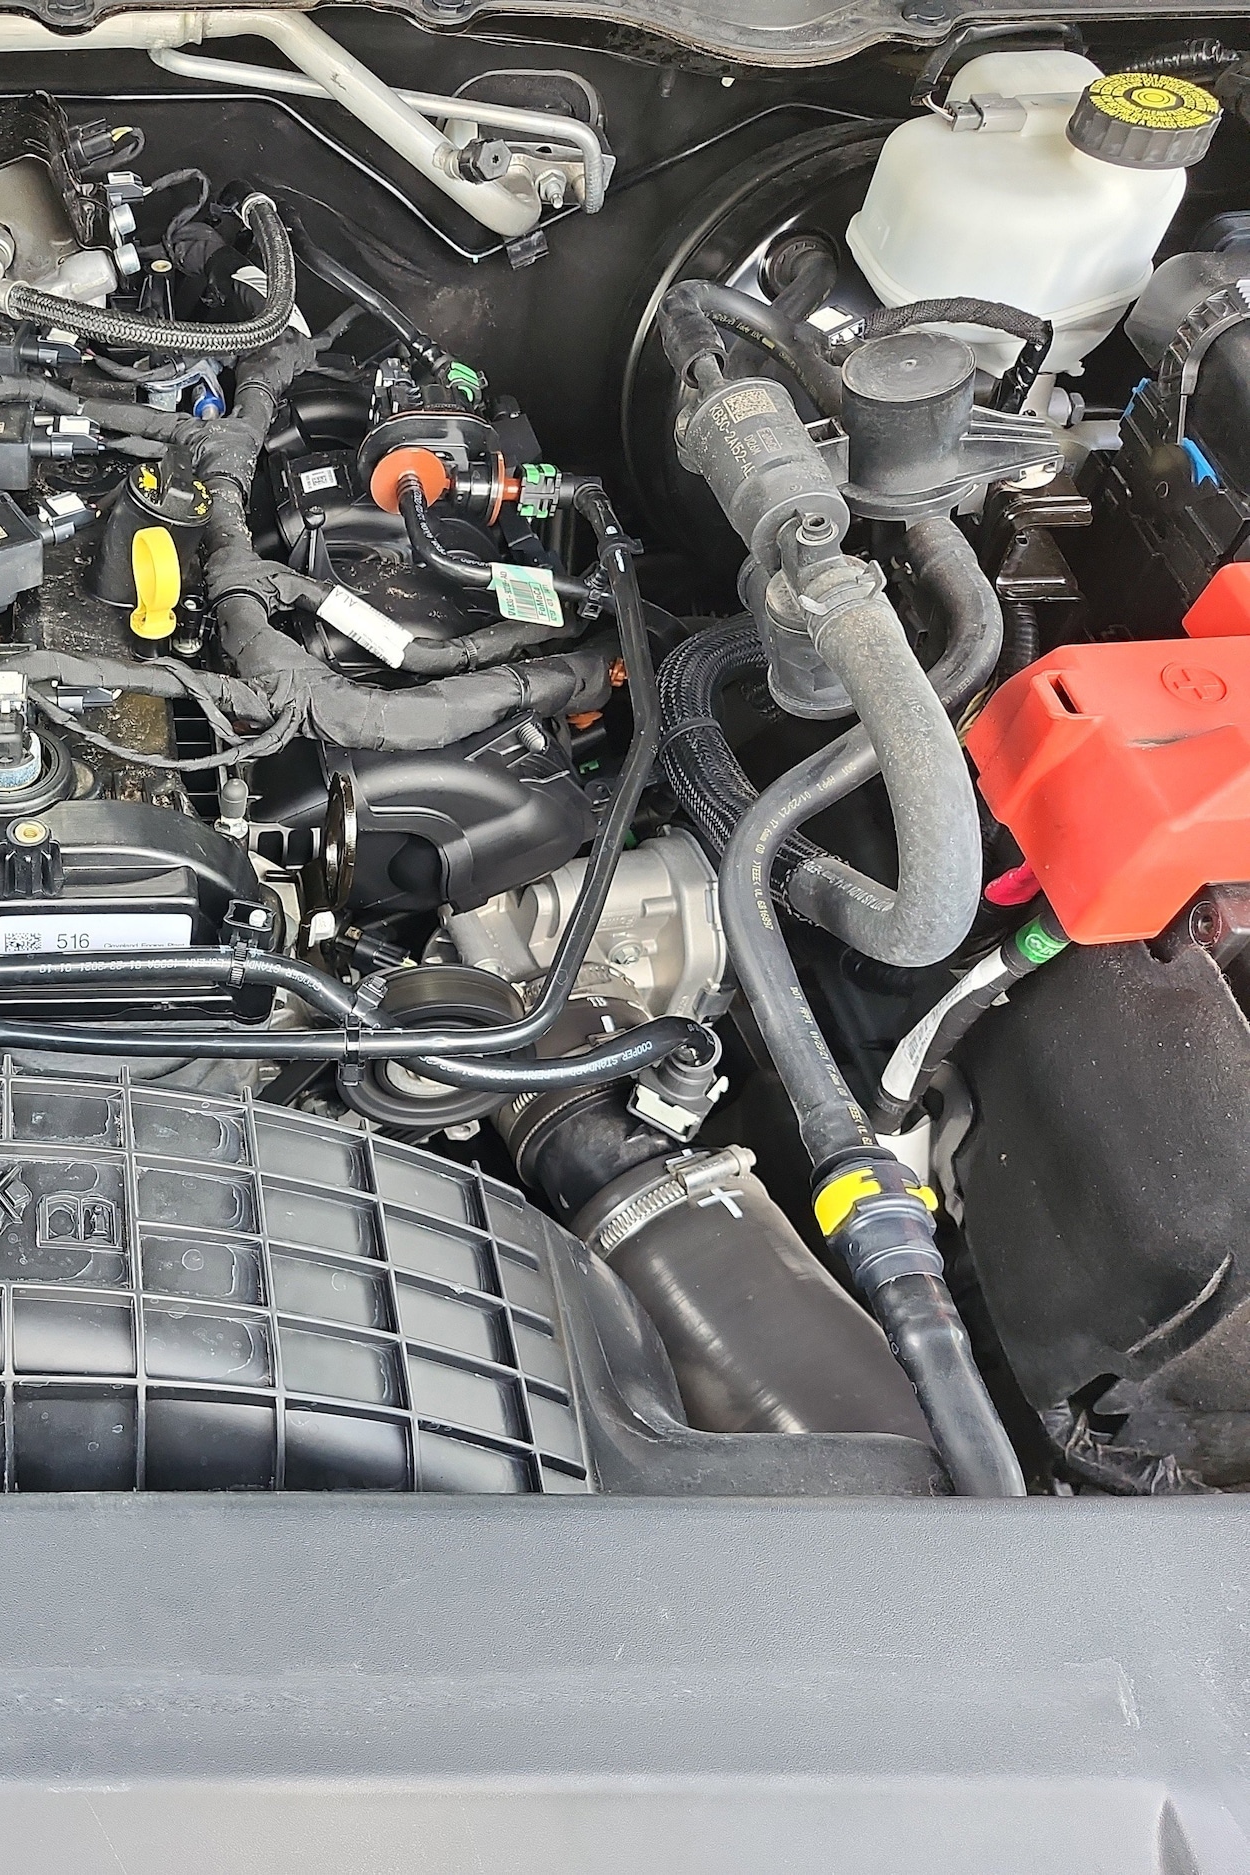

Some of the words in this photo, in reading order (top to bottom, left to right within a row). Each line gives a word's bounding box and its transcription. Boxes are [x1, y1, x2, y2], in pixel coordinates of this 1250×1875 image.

[56, 933, 90, 949] 516
[621, 1040, 652, 1060] COOPER
[569, 1055, 617, 1076] STANDARD
